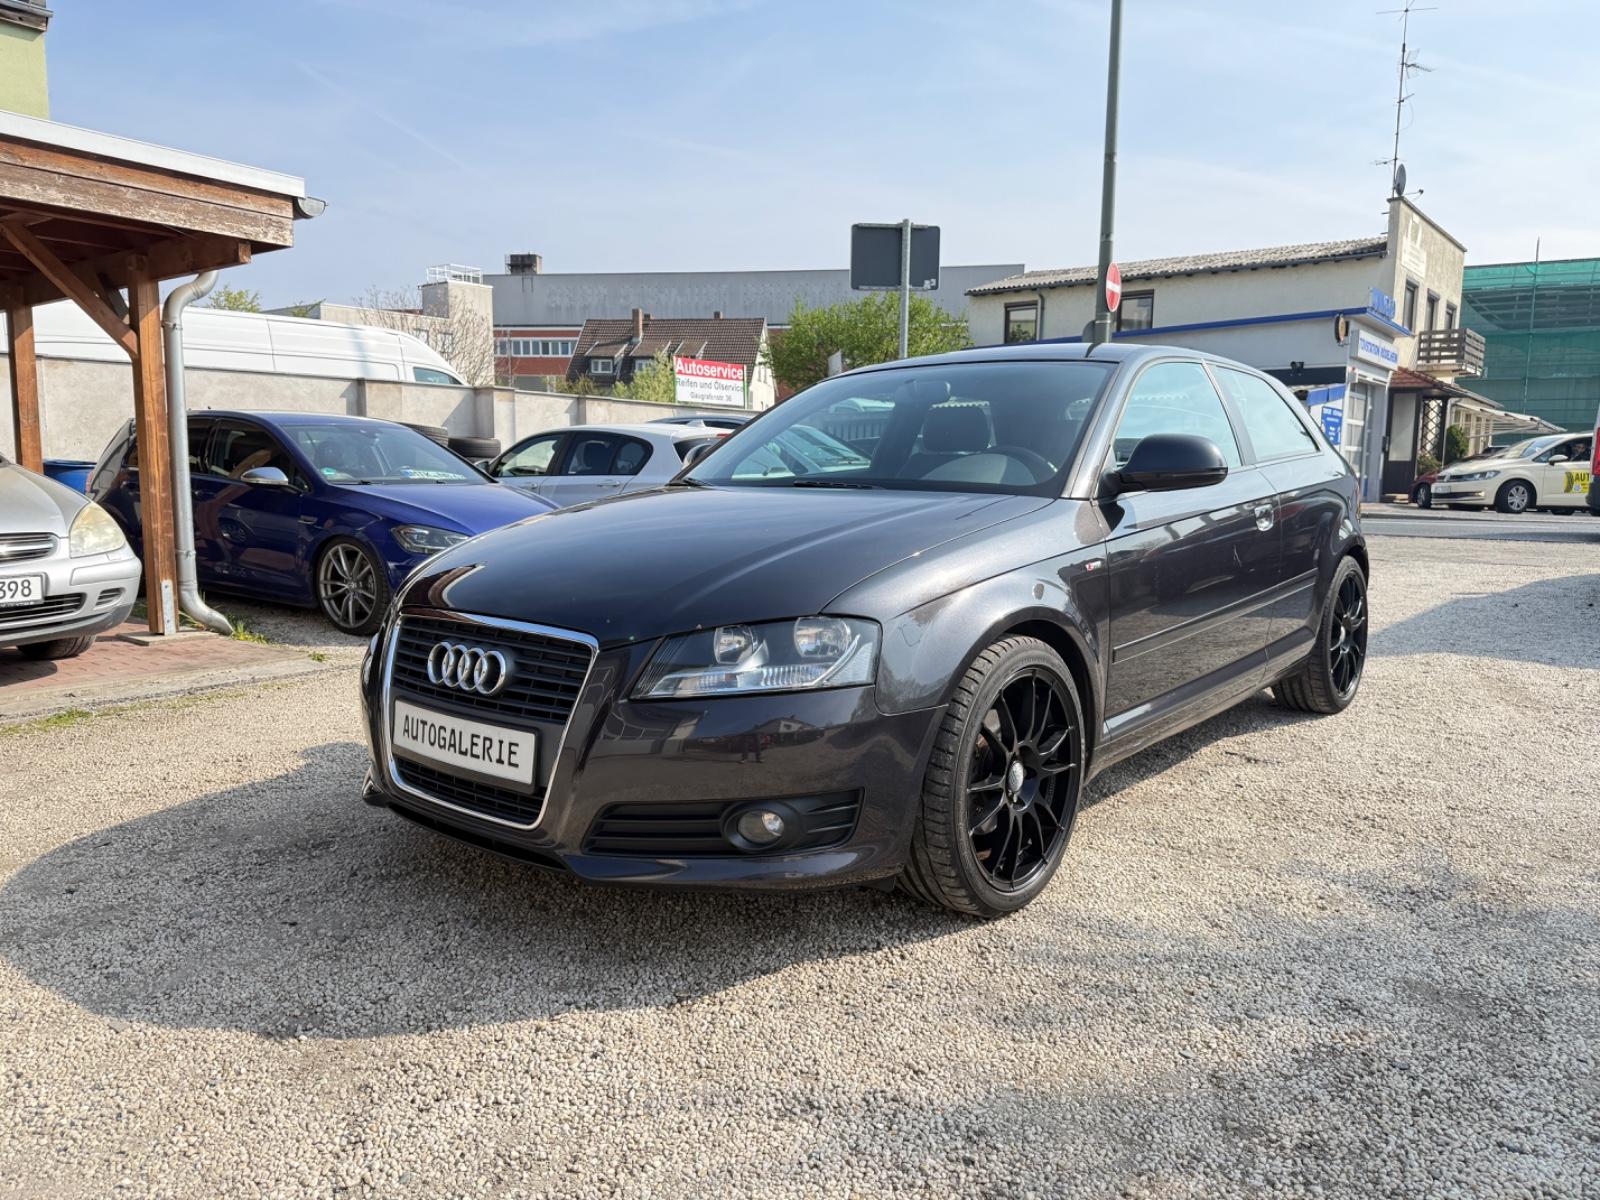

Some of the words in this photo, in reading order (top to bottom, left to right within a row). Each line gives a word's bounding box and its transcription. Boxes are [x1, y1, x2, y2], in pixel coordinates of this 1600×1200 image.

[676, 357, 743, 380] Autoservice
[675, 377, 698, 389] Reifen
[699, 380, 713, 390] und
[402, 714, 520, 769] AUTOGALERIE
